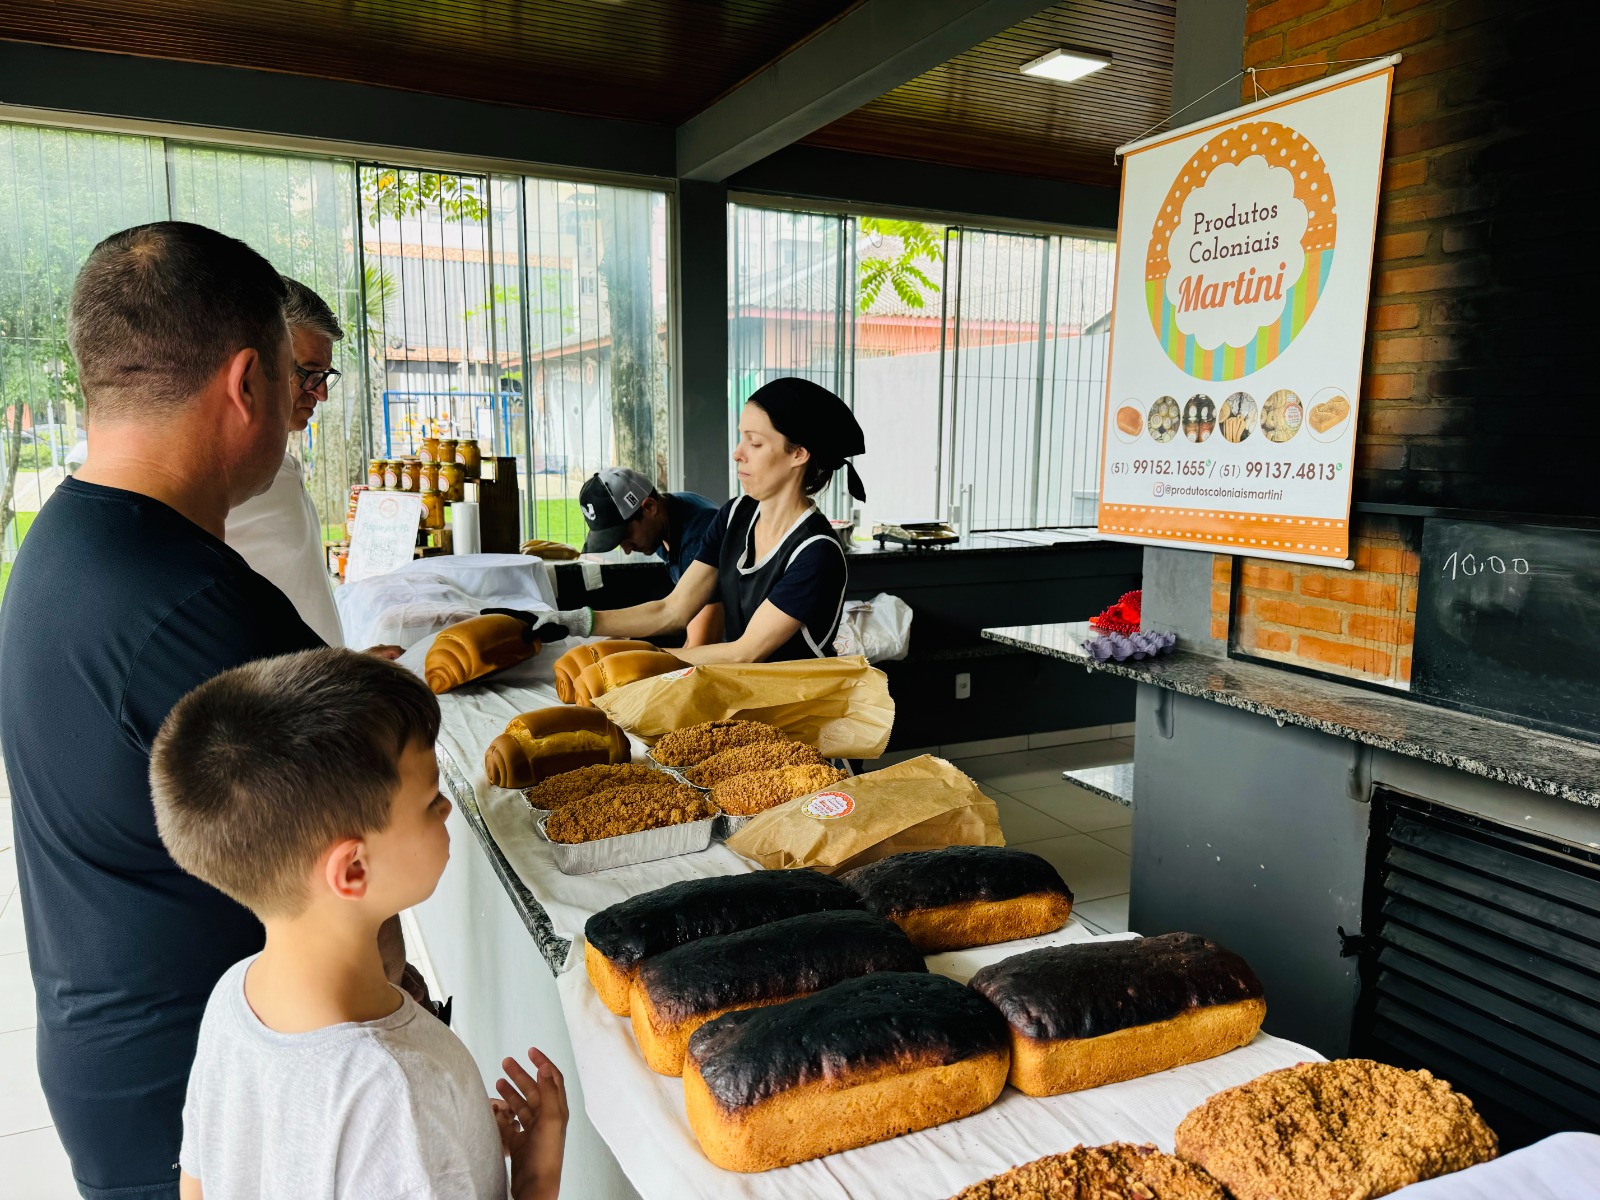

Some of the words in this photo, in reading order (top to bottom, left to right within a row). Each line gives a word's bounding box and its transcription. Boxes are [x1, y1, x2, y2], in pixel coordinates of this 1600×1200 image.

[1193, 202, 1278, 235] Produtos
[1189, 231, 1279, 263] Coloniais
[1177, 261, 1287, 313] Martini
[1110, 461, 1129, 475] (51)
[1133, 459, 1205, 476] 99152.1655
[1219, 463, 1241, 479] (51)
[1245, 461, 1335, 481] 99137.4813
[1164, 484, 1283, 501] @produtoscoloniaismartini
